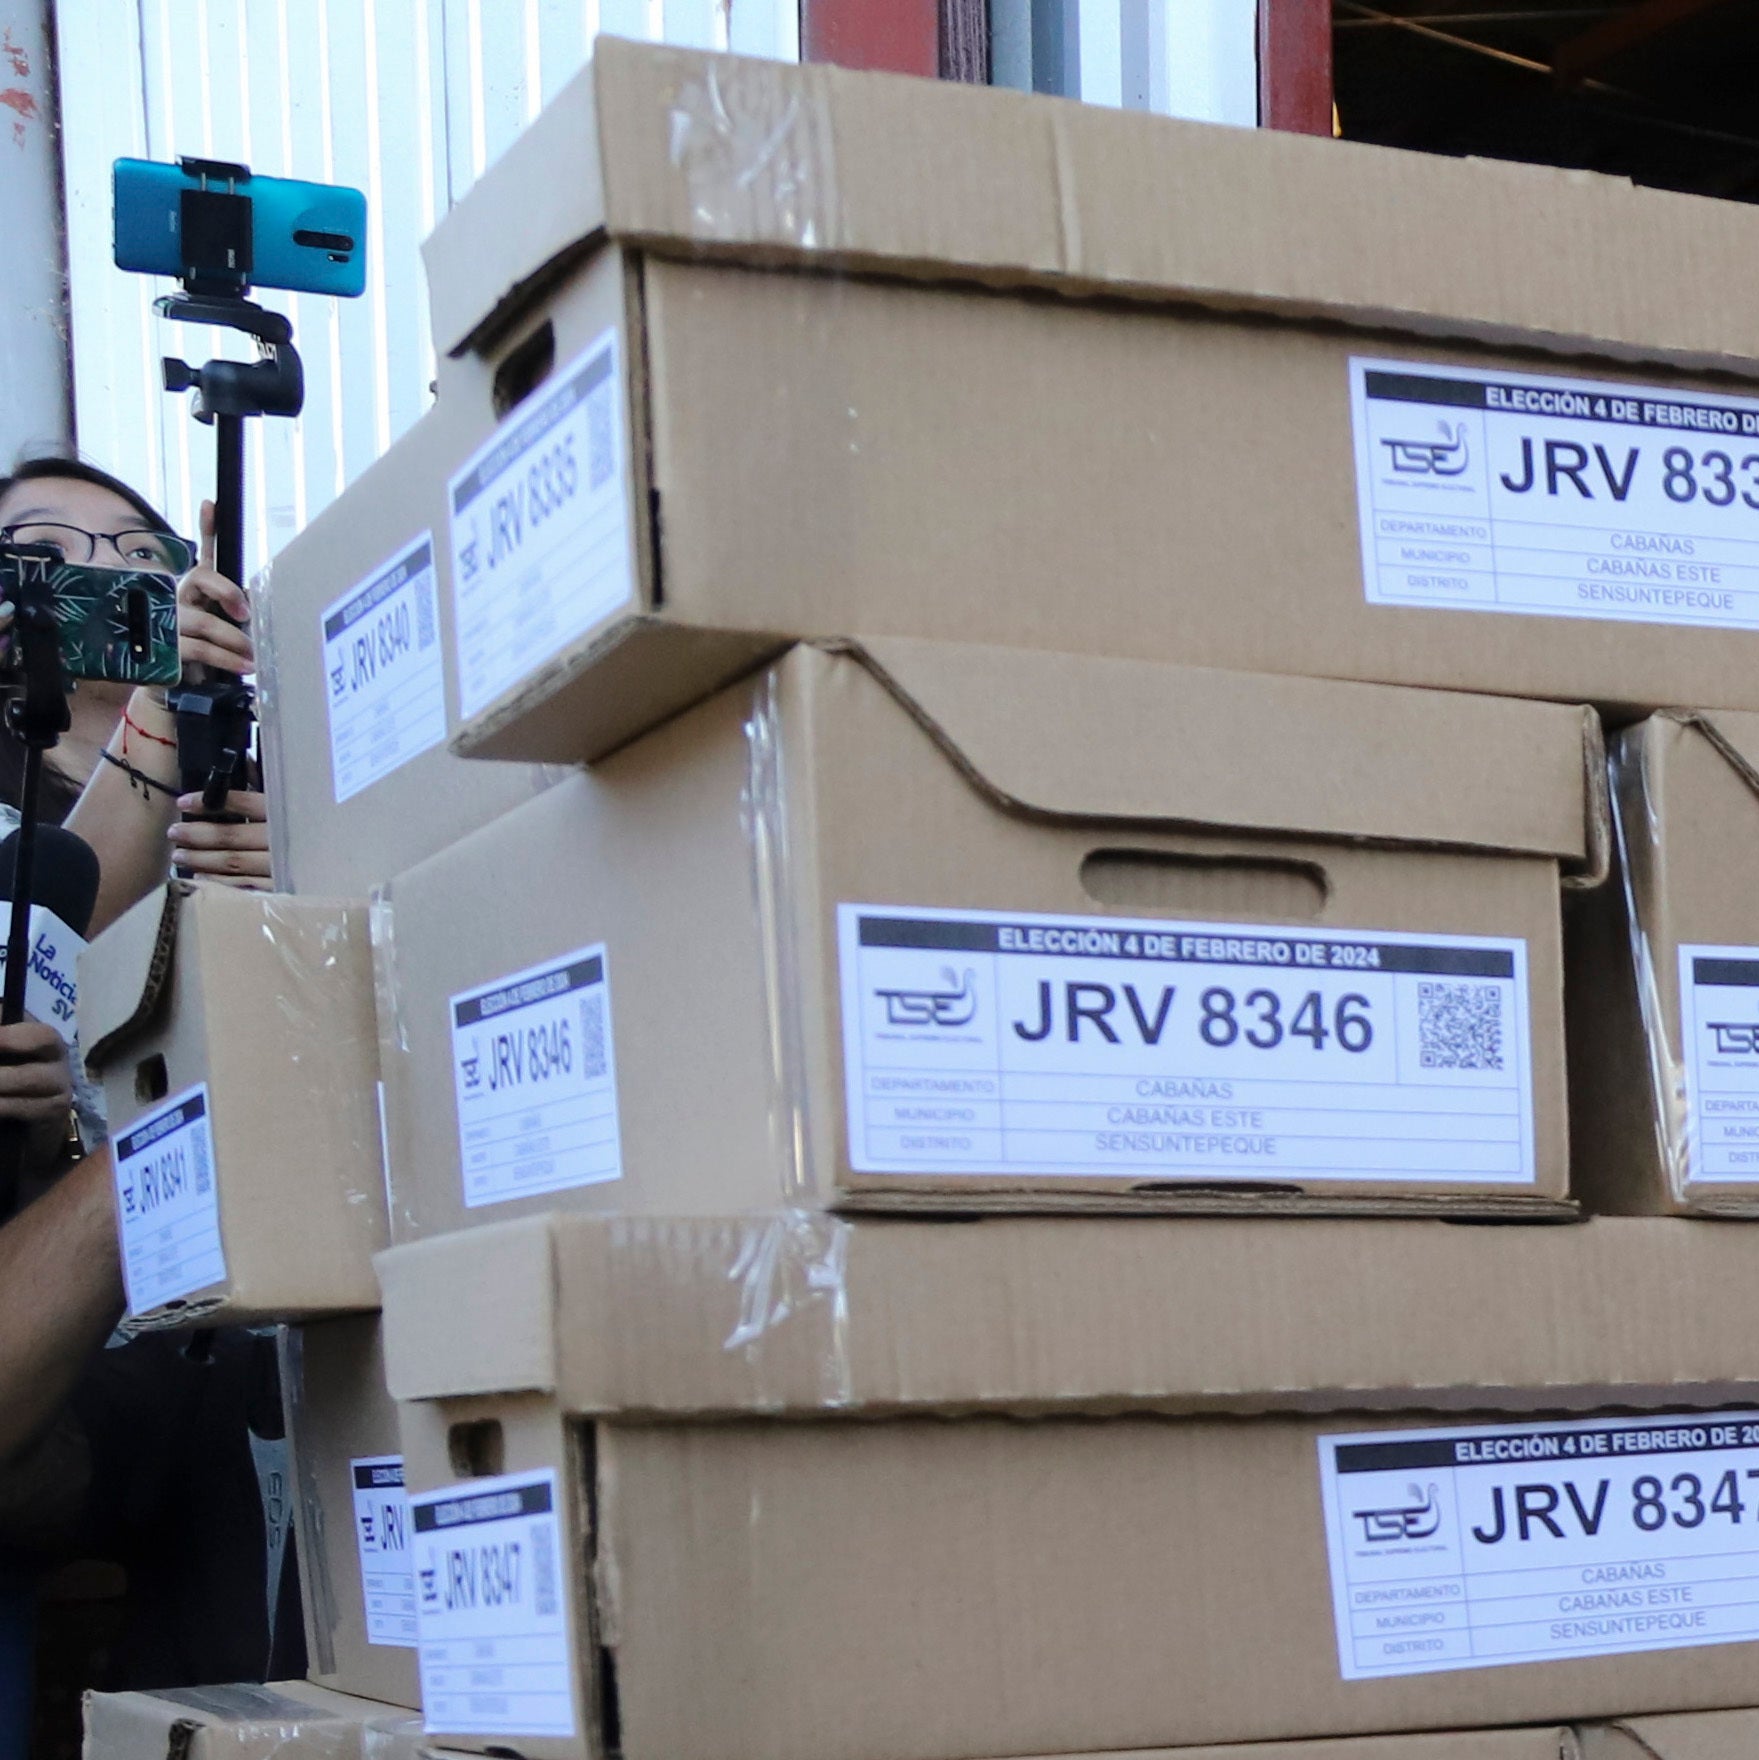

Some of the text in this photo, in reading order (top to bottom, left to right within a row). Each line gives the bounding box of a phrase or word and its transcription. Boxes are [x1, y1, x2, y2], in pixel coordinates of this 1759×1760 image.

[1484, 382, 1591, 418] ELECCIÓN
[1592, 396, 1608, 419] 4
[1610, 398, 1640, 423] DE
[1642, 401, 1739, 433] FEBRERO
[1500, 437, 1639, 501] JRV
[486, 481, 522, 568] JRV
[351, 601, 410, 691] JRV 8340
[35, 933, 57, 961] La
[1013, 980, 1372, 1053] JRV 8346
[489, 1017, 571, 1091] JRV 8346
[1453, 1433, 1560, 1462] ELECCIÓN
[1561, 1434, 1577, 1455] 4
[1578, 1433, 1609, 1454] DE
[1610, 1427, 1708, 1452] FEBRERO
[1709, 1425, 1739, 1446] DE
[265, 1471, 283, 1549] EOS
[381, 1503, 403, 1551] JRV
[1472, 1478, 1609, 1545] JRV
[445, 1548, 477, 1610] JRV
